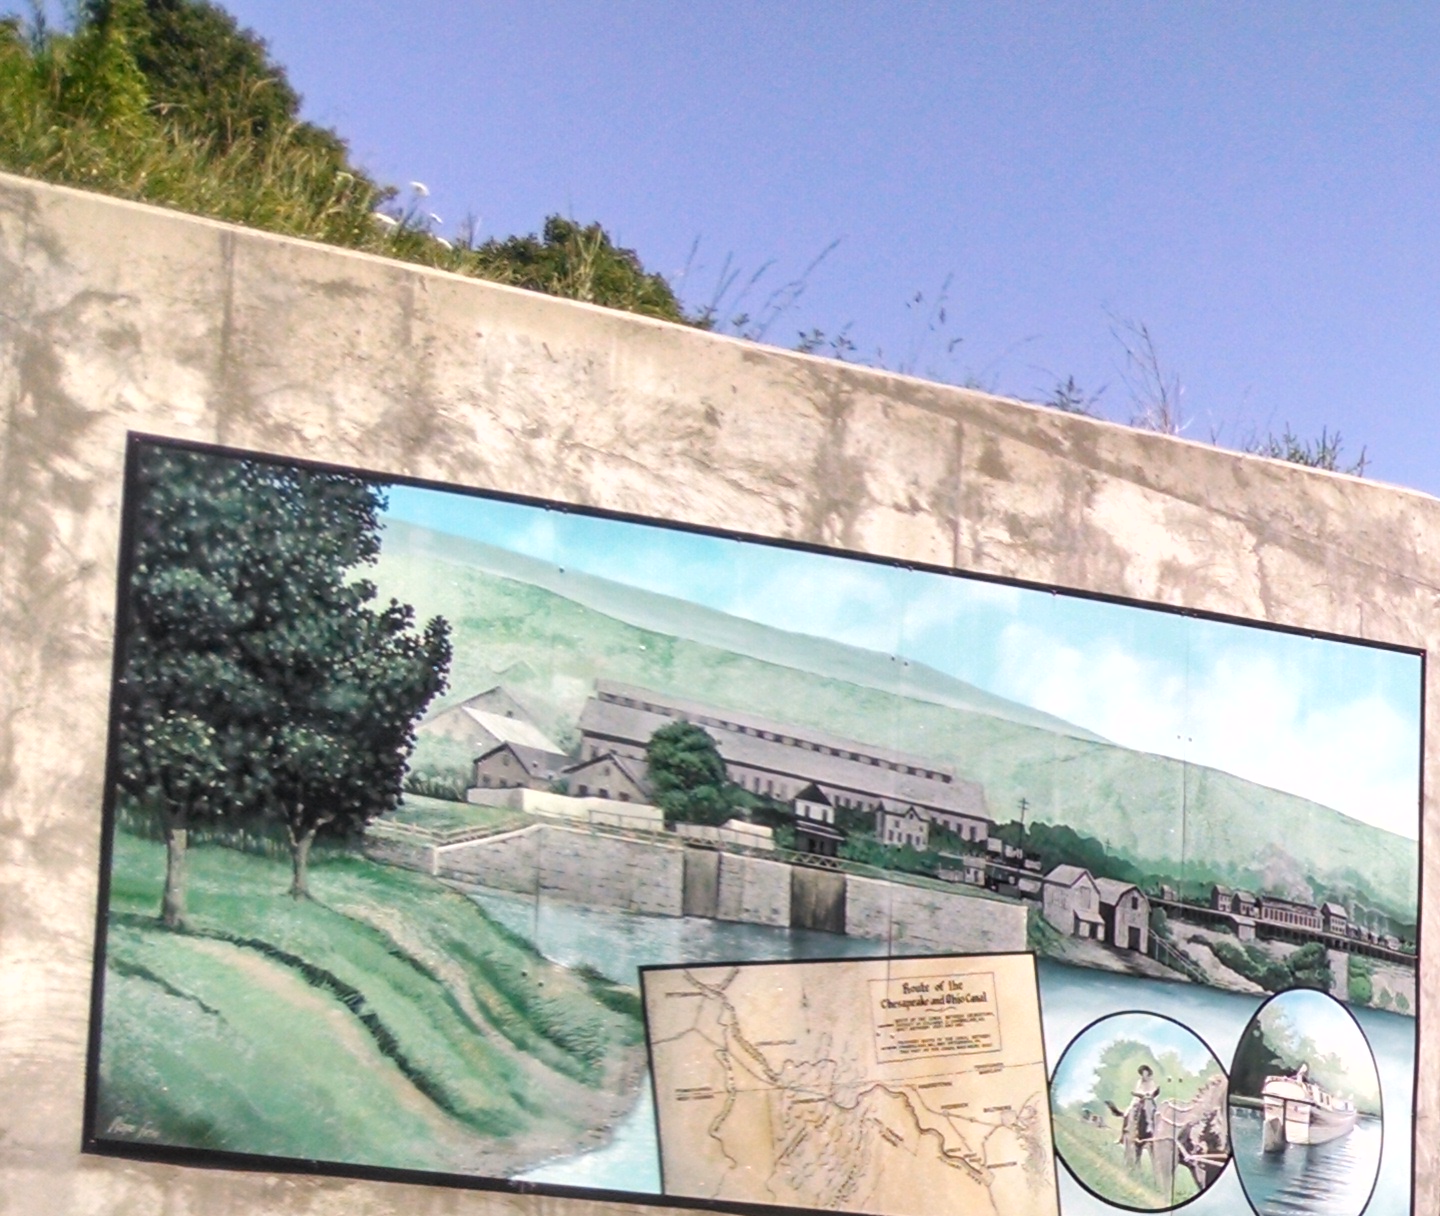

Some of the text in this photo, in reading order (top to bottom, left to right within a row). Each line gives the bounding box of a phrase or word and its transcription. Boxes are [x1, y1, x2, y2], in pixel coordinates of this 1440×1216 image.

[902, 980, 963, 994] Route of the
[880, 994, 929, 1011] Chesapeake
